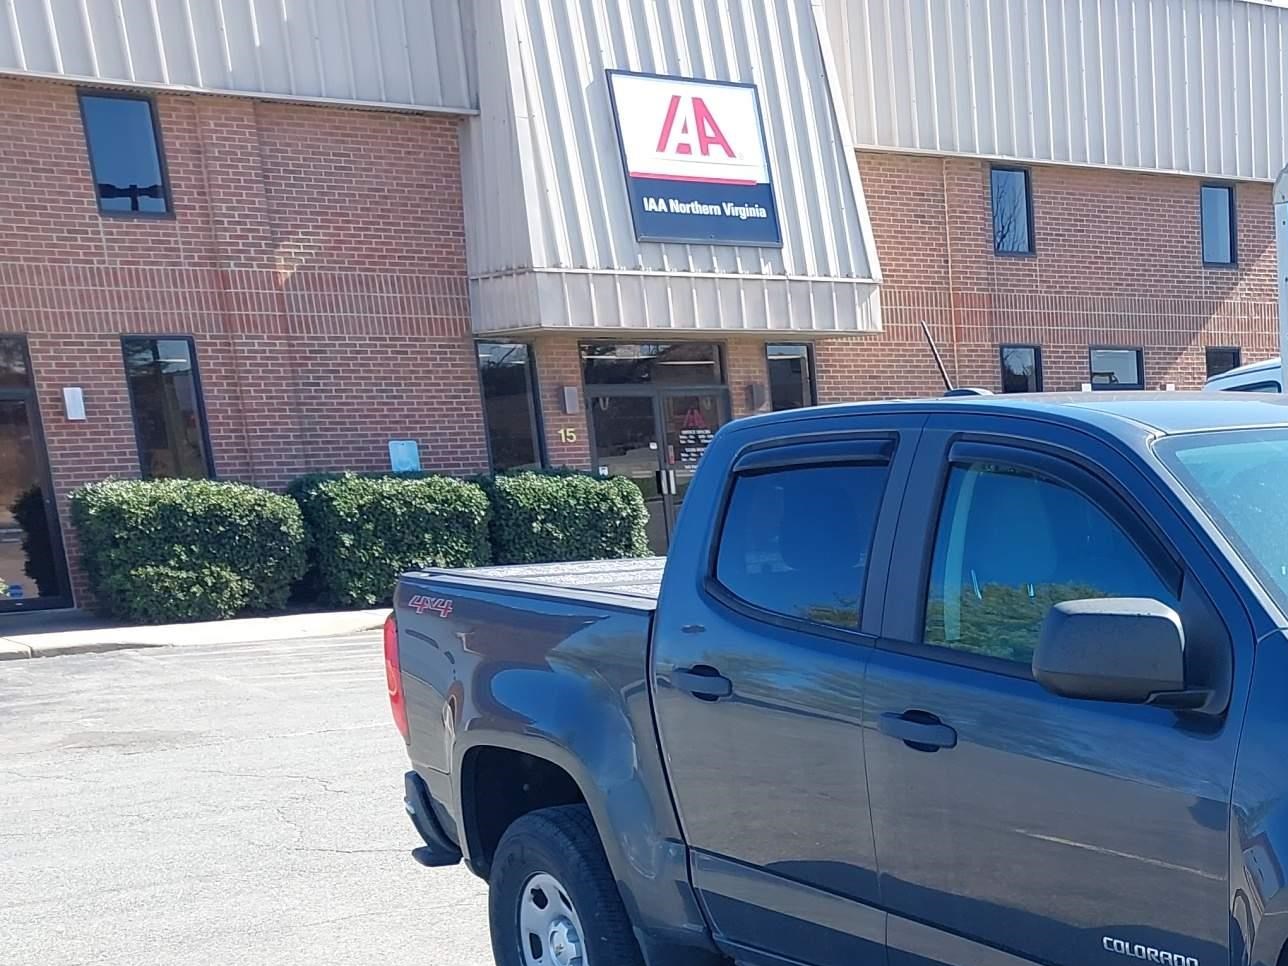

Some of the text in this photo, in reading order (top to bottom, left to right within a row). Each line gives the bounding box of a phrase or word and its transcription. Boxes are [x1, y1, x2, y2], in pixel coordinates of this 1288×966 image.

[656, 95, 736, 158] IAA
[643, 197, 767, 220] IAA Northern Virginia
[557, 428, 577, 443] 15
